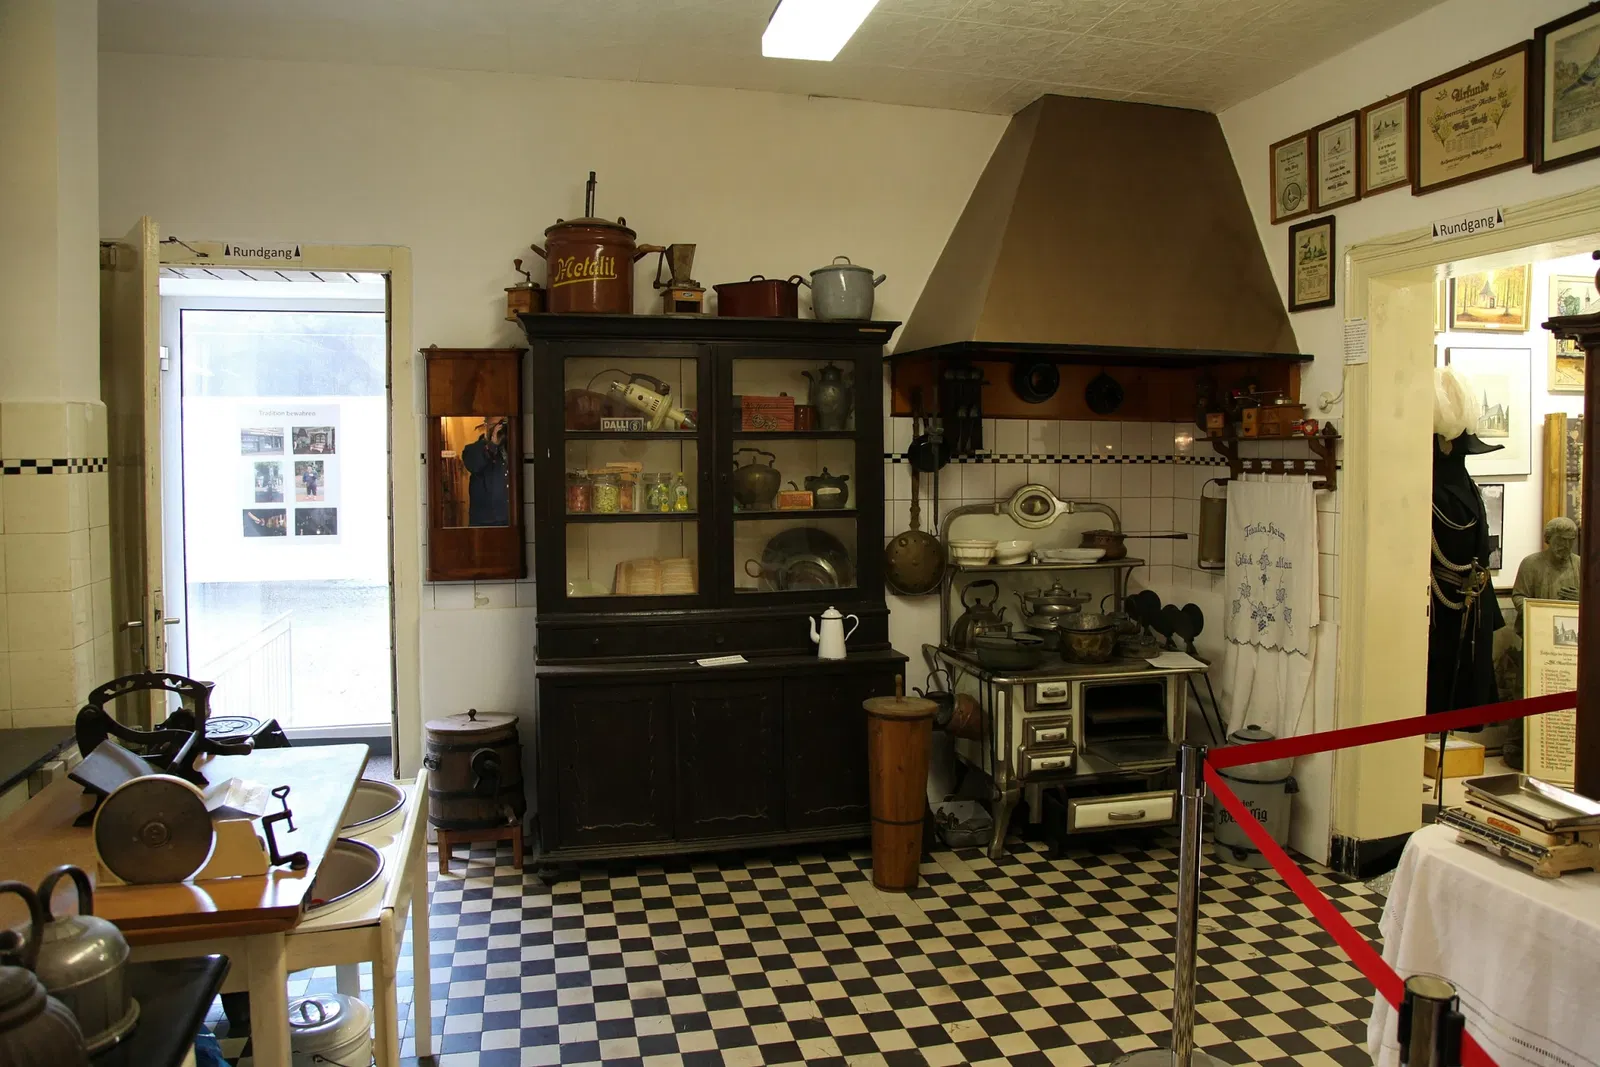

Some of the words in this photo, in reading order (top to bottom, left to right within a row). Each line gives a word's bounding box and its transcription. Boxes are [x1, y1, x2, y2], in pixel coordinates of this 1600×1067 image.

[1451, 80, 1489, 103] Urkunde
[1439, 216, 1495, 237] Rundgang
[233, 246, 293, 259] Rundgang
[554, 255, 616, 283] Metalit
[258, 409, 285, 417] Tradition
[286, 409, 316, 417] bewahren
[603, 420, 629, 429] DALLI
